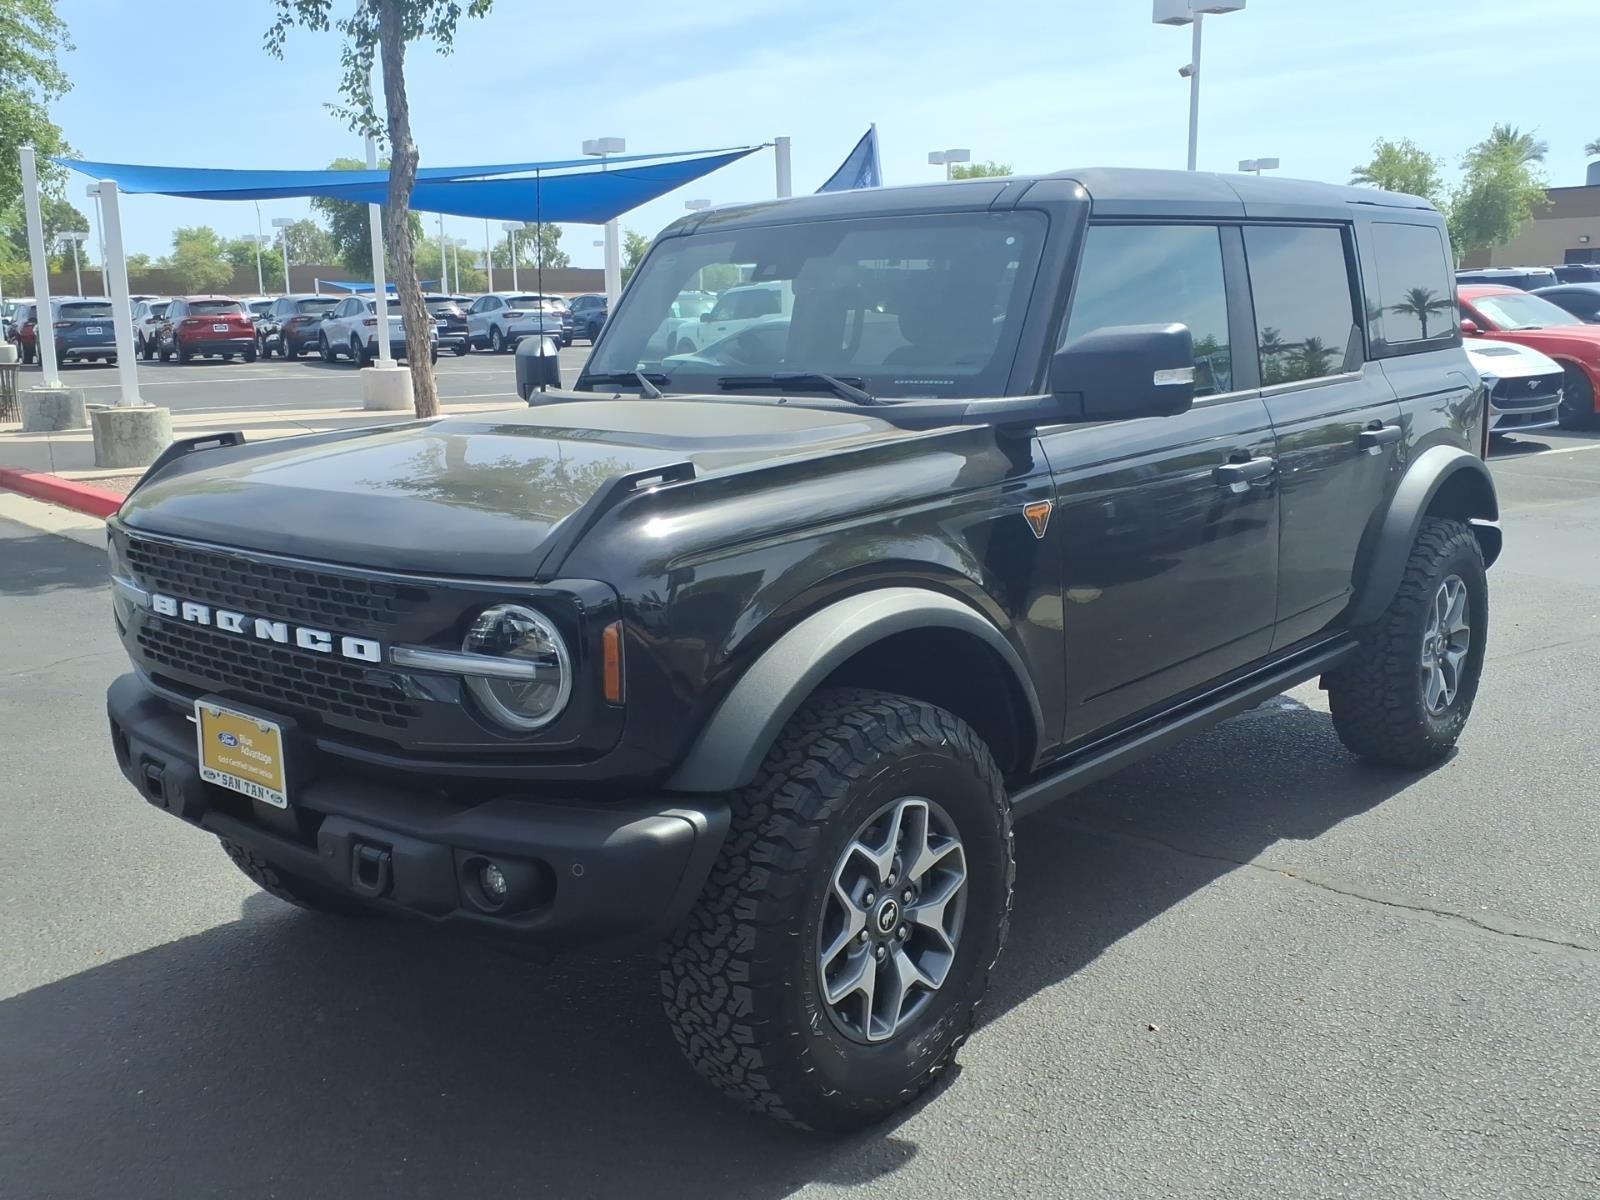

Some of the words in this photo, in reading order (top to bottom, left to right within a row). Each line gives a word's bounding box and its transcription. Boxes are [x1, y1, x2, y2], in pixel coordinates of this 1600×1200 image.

[152, 593, 381, 663] BRONCO
[222, 774, 241, 790] SAN
[244, 781, 264, 799] TAN
